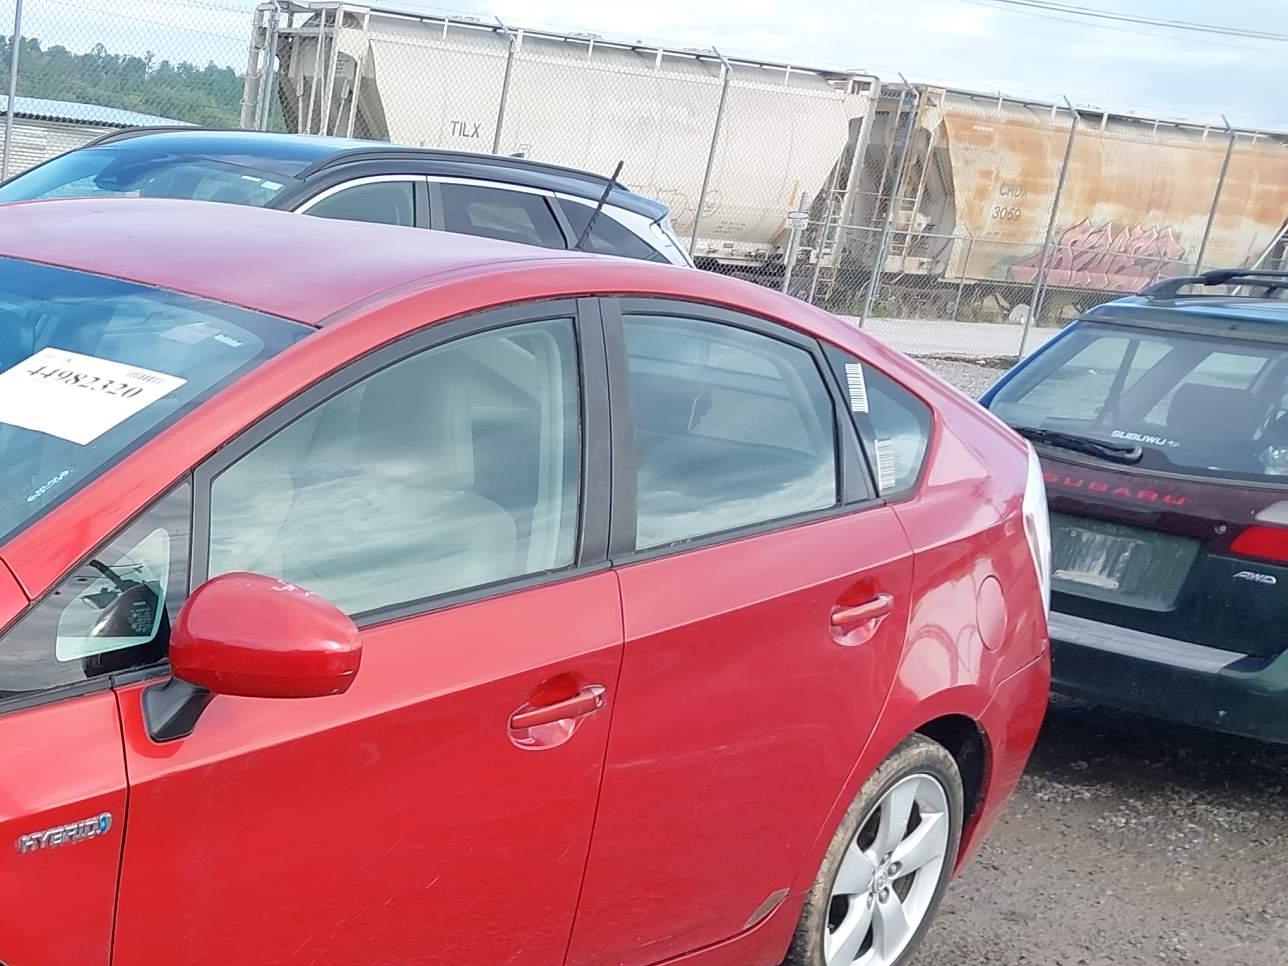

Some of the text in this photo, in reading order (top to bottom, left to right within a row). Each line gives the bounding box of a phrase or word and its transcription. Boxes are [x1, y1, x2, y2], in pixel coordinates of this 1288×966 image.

[451, 120, 482, 138] TILX
[992, 206, 1022, 221] 3069
[27, 365, 144, 399] 44982320
[1111, 429, 1167, 445] SUBUWU
[1043, 471, 1187, 505] SUBARU
[1232, 571, 1277, 585] AWD
[17, 817, 100, 853] HYBRID
